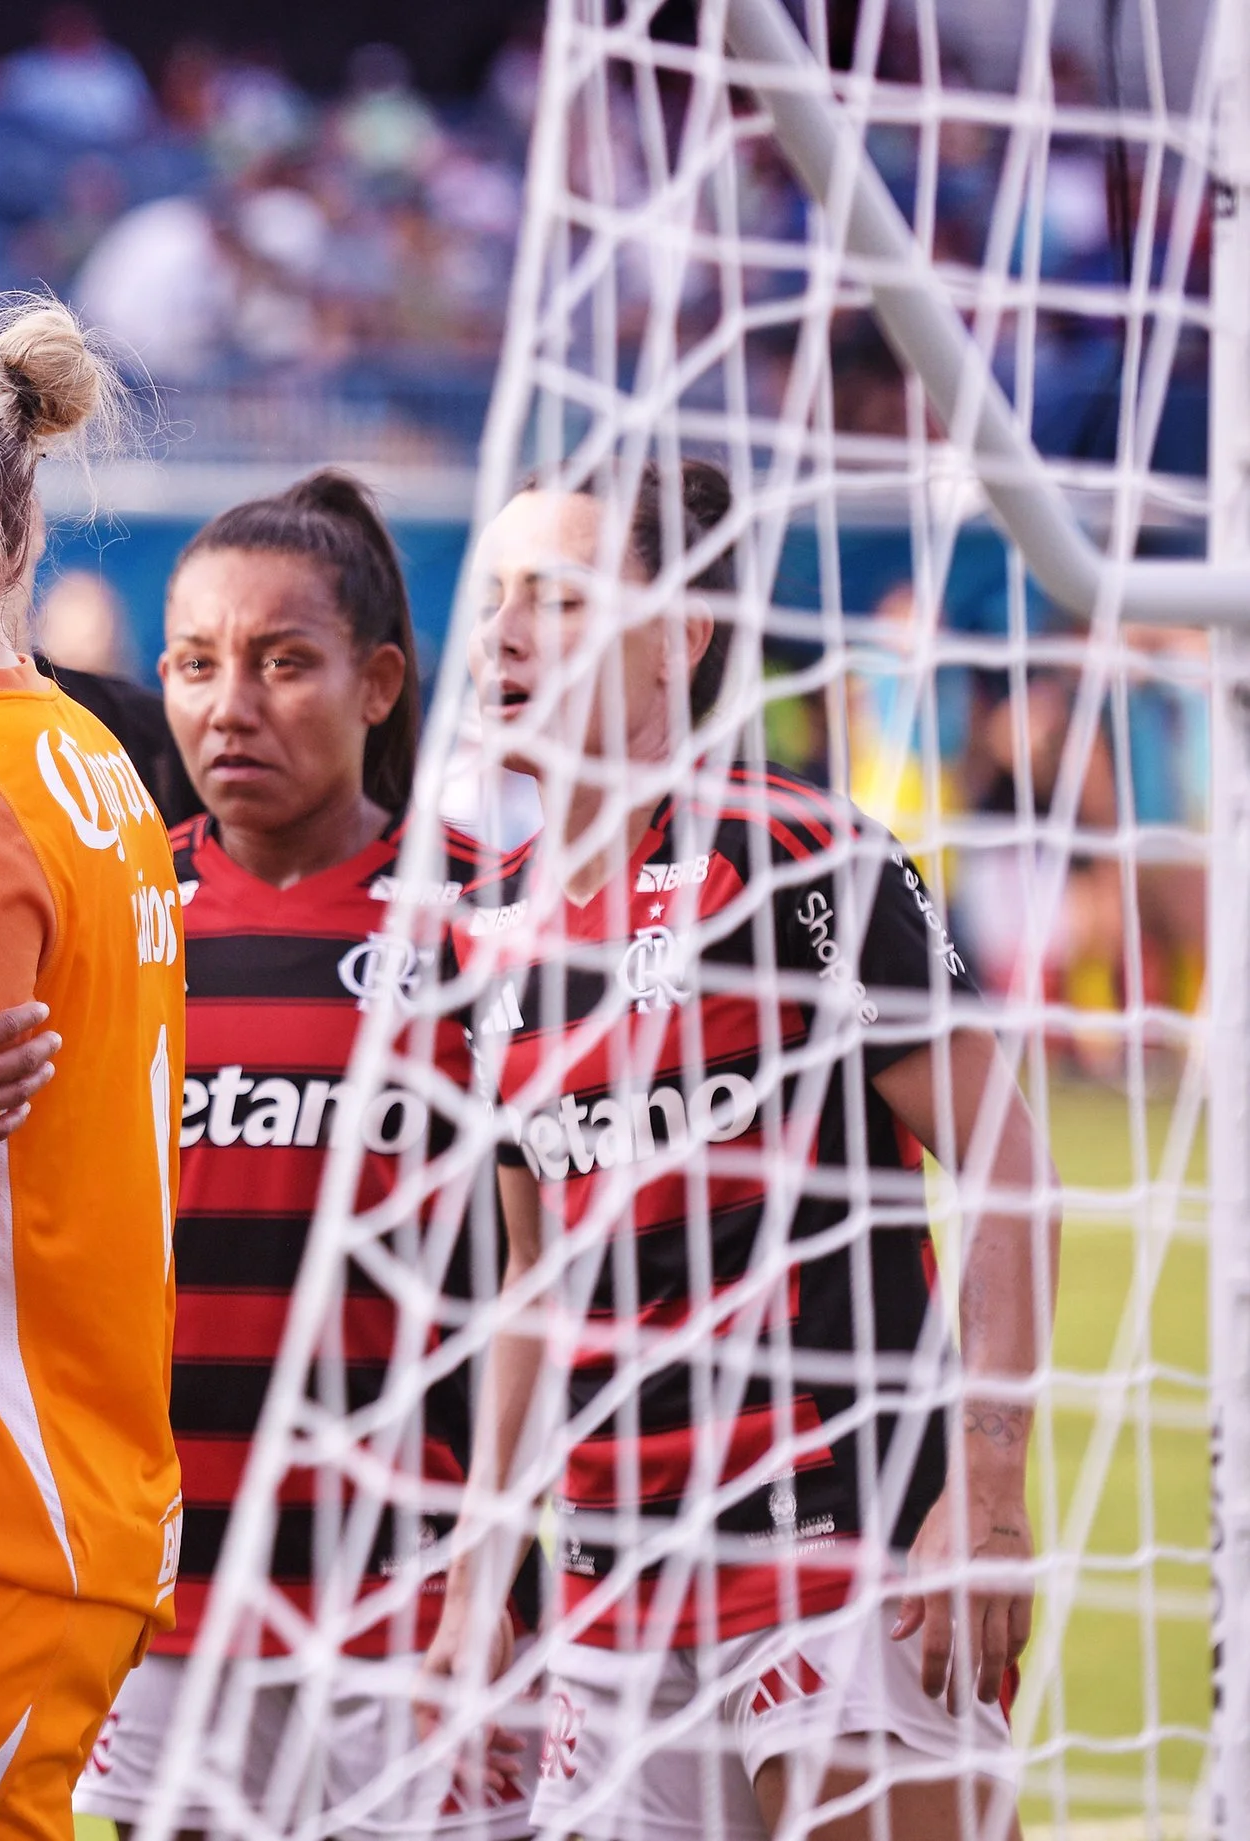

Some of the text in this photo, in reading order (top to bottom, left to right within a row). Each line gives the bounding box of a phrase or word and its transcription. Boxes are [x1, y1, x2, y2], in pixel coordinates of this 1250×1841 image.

[797, 890, 879, 1025] Shopee
[180, 1064, 429, 1155] etano
[506, 1072, 758, 1182] etano
